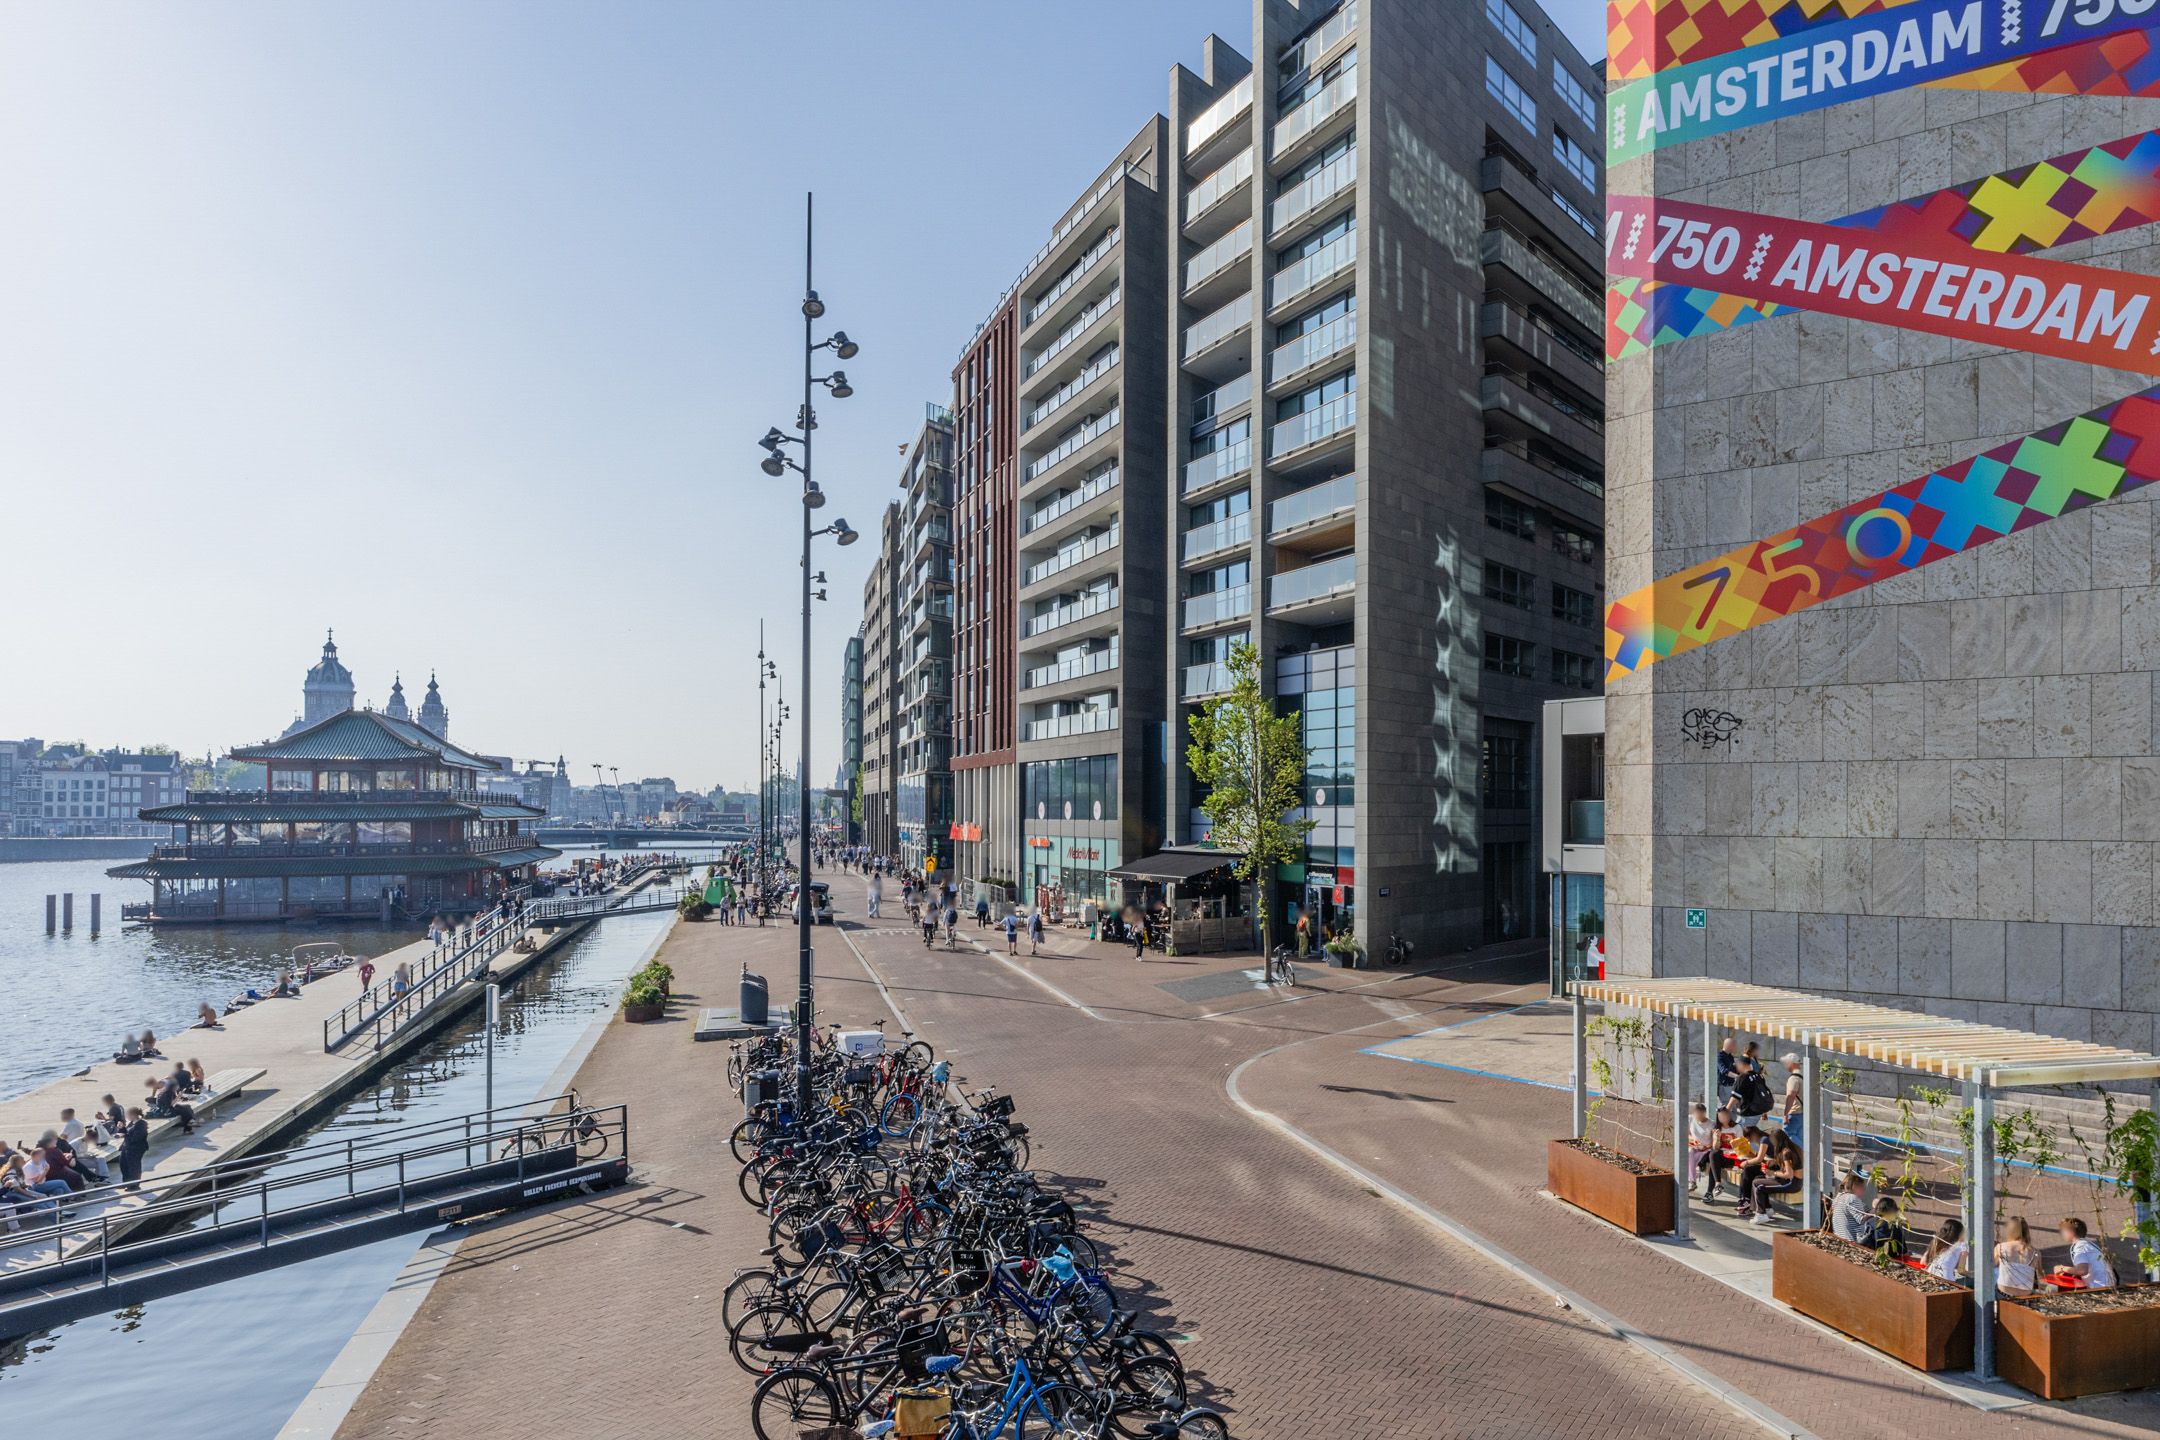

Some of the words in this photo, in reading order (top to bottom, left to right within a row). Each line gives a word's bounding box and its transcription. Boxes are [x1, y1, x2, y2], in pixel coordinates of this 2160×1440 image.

[1637, 1, 1982, 141] AMSTERDAM
[2040, 0, 2156, 37] 75
[1647, 215, 1740, 275] 750
[1770, 239, 2150, 351] AMSTERDAM
[1683, 508, 1912, 630] 750
